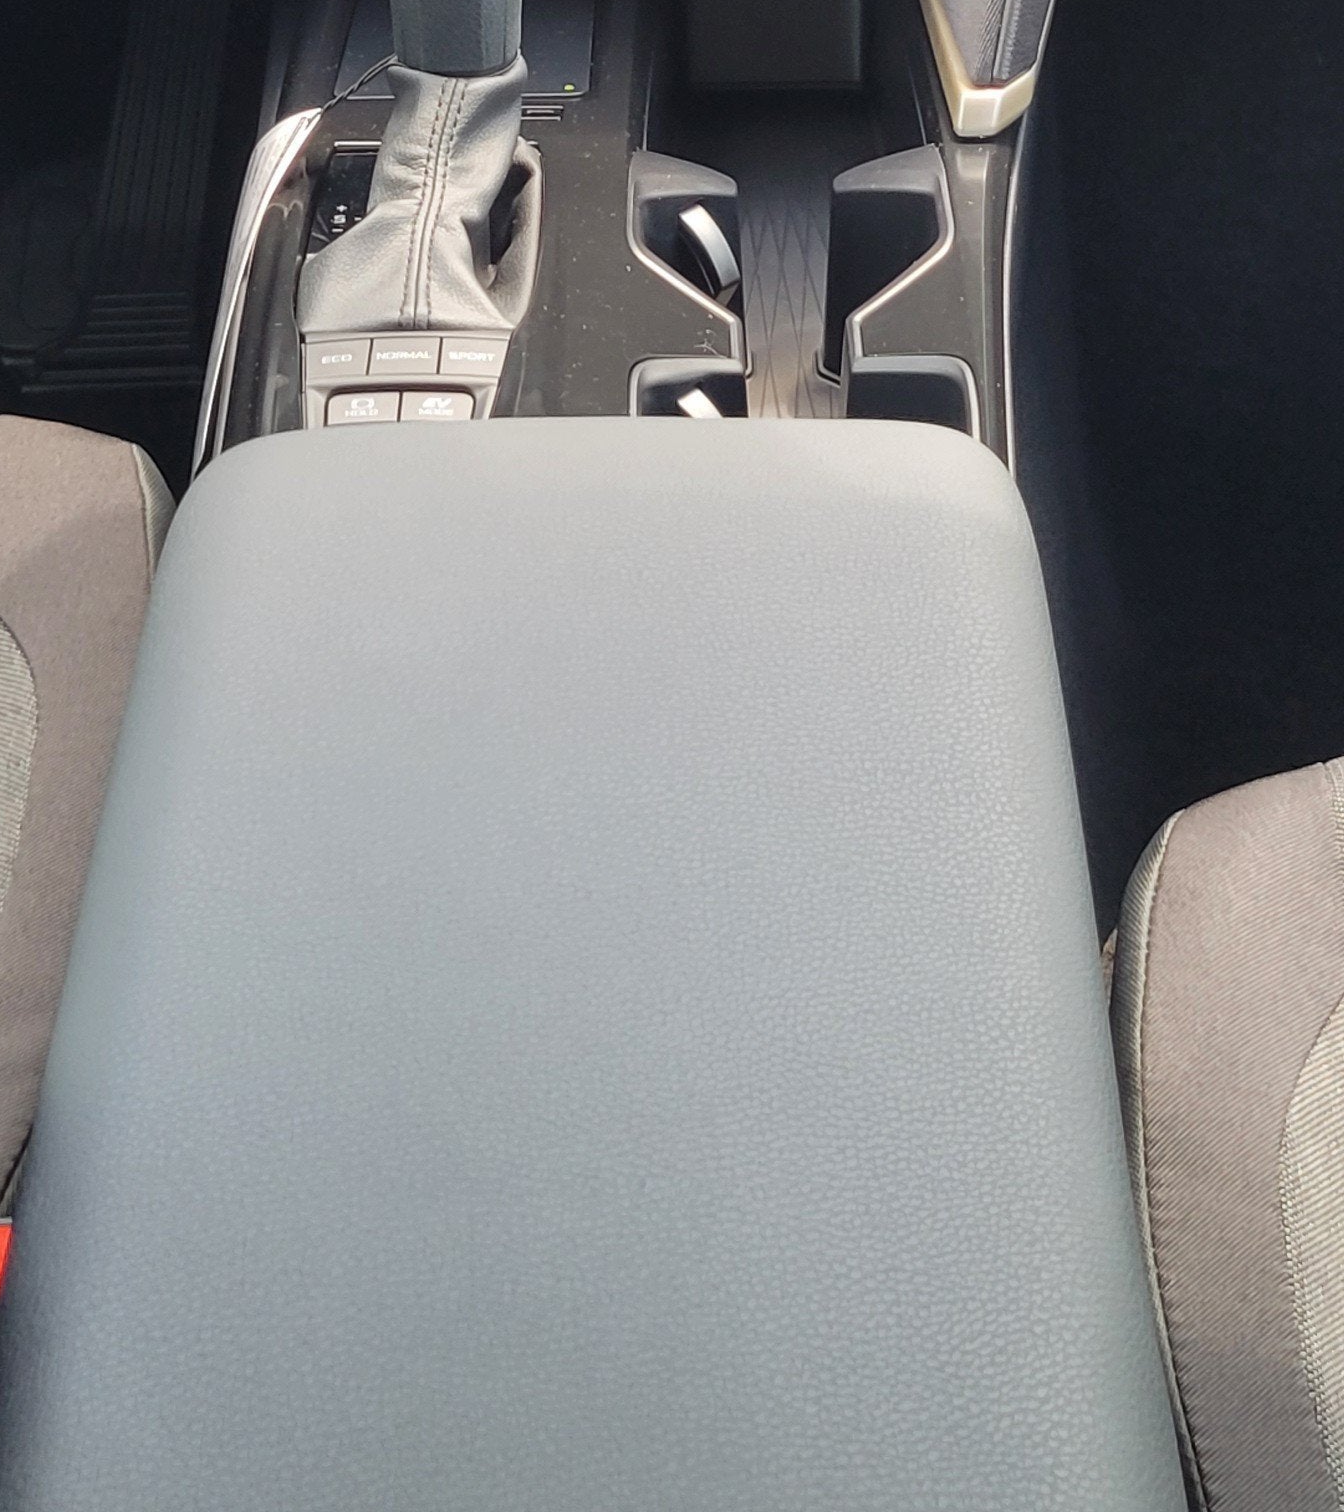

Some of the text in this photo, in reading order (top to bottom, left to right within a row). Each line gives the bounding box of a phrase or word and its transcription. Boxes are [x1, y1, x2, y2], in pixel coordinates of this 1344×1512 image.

[321, 352, 353, 365] ECO
[376, 350, 432, 361] NORMAL
[448, 352, 496, 362] SPORT
